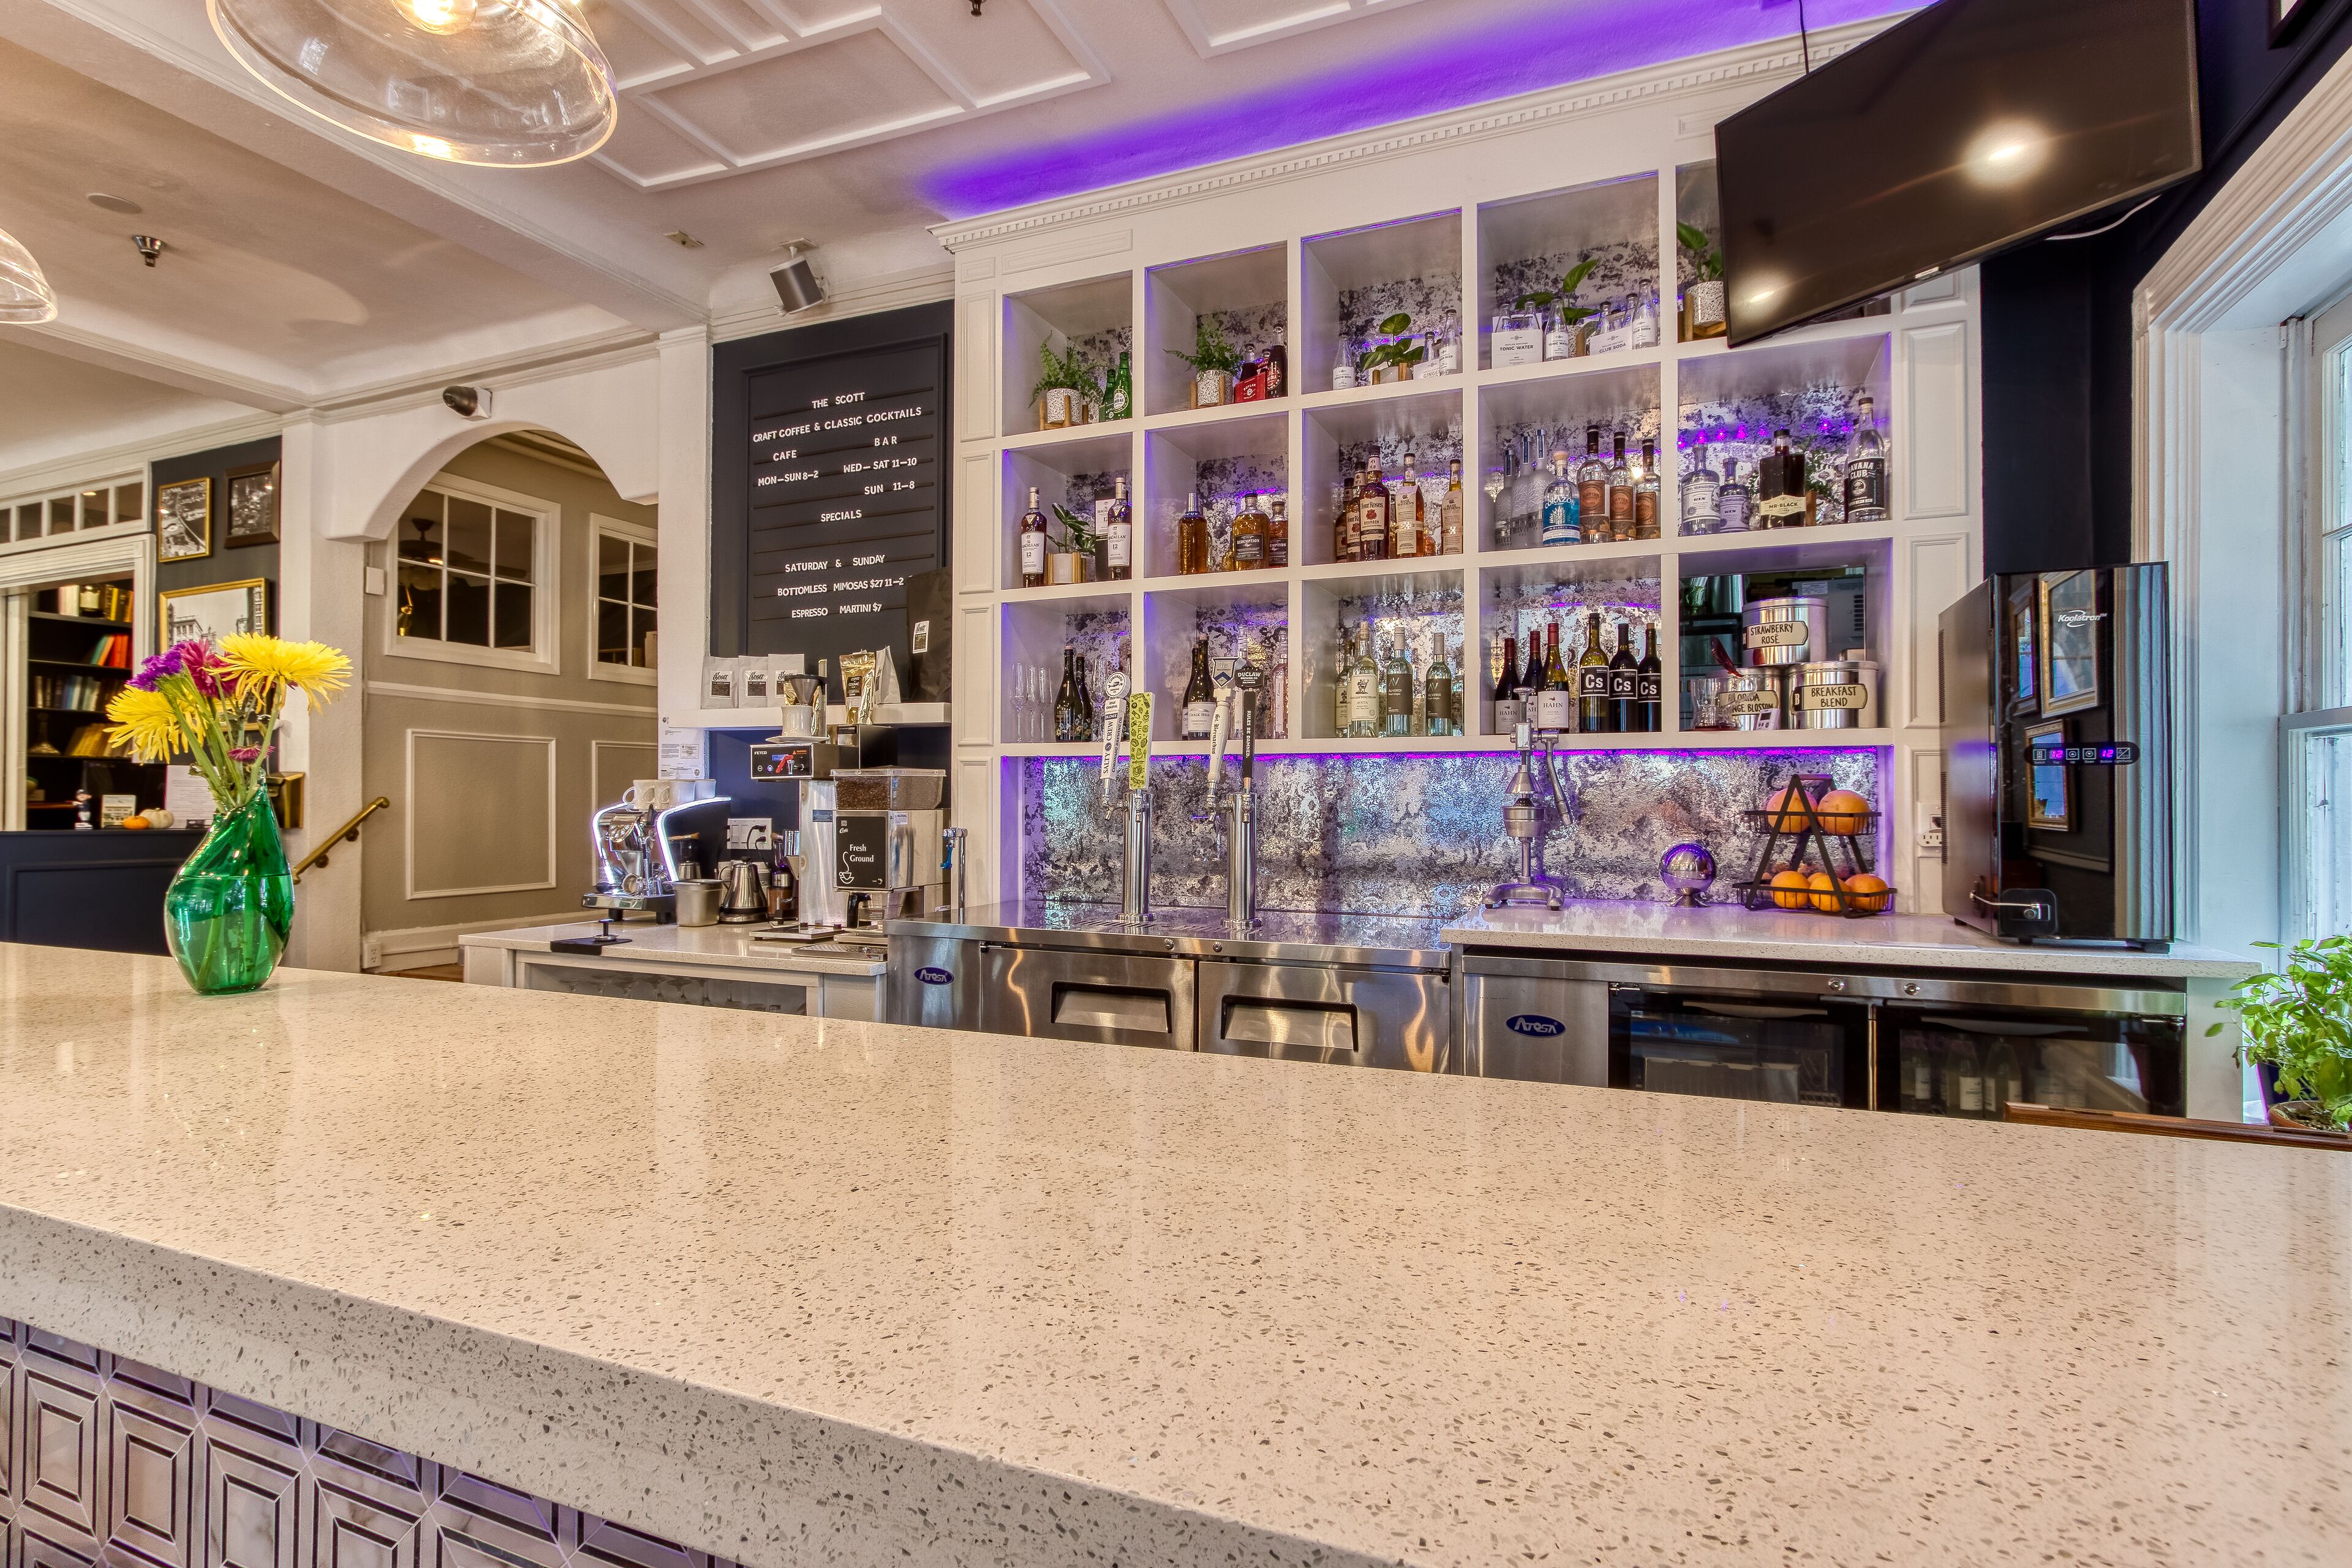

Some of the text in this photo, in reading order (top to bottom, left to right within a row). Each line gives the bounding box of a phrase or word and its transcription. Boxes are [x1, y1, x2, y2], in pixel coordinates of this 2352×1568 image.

[812, 392, 865, 409] THE SCOTT
[753, 407, 922, 443] CRAFT COFFEE & CLASSIC COCKTAILS
[773, 450, 797, 461] CAFE
[873, 459, 889, 470] SAT
[1850, 469, 1868, 480] CLUB
[864, 484, 884, 495] SUN
[821, 510, 862, 522] SPECIALS
[785, 554, 885, 573] SATURDAY & SUNDAY
[778, 584, 827, 597] BOTTOMLESS
[833, 581, 869, 592] MIMOSAS
[870, 579, 883, 589] $27
[791, 603, 882, 619] ESPRESSO MARTINI $7
[1751, 623, 1793, 636] STRAWBERRY
[1762, 633, 1780, 644] ROSÉ
[713, 671, 729, 681] Scott
[748, 671, 764, 681] Scott
[1109, 675, 1123, 684] CORONADO
[1585, 674, 1604, 688] Cs
[1614, 678, 1631, 691] Cs
[1640, 682, 1657, 695] Cs
[1811, 686, 1857, 697] BREAKFAST
[1795, 693, 1800, 706] B
[1820, 698, 1848, 707] BLEND
[2052, 750, 2063, 758] 12
